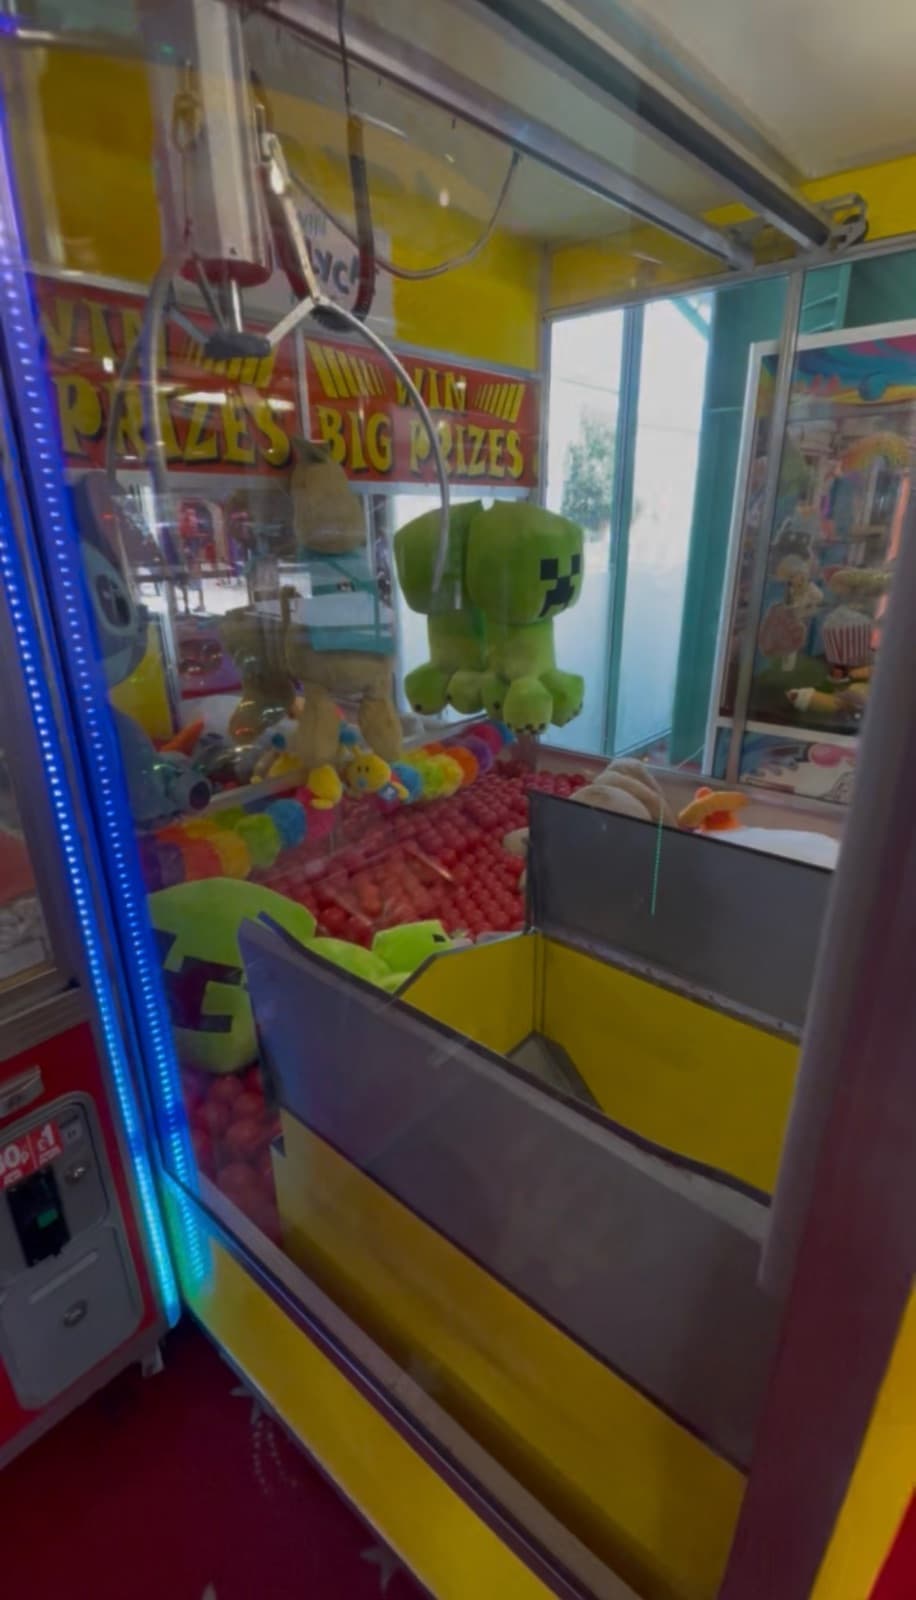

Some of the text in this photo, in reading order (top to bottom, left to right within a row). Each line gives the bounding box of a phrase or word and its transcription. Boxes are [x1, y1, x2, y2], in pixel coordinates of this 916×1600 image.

[52, 374, 292, 468] PRIZES
[395, 366, 468, 414] WIN
[316, 404, 525, 480] BIG PRIZES
